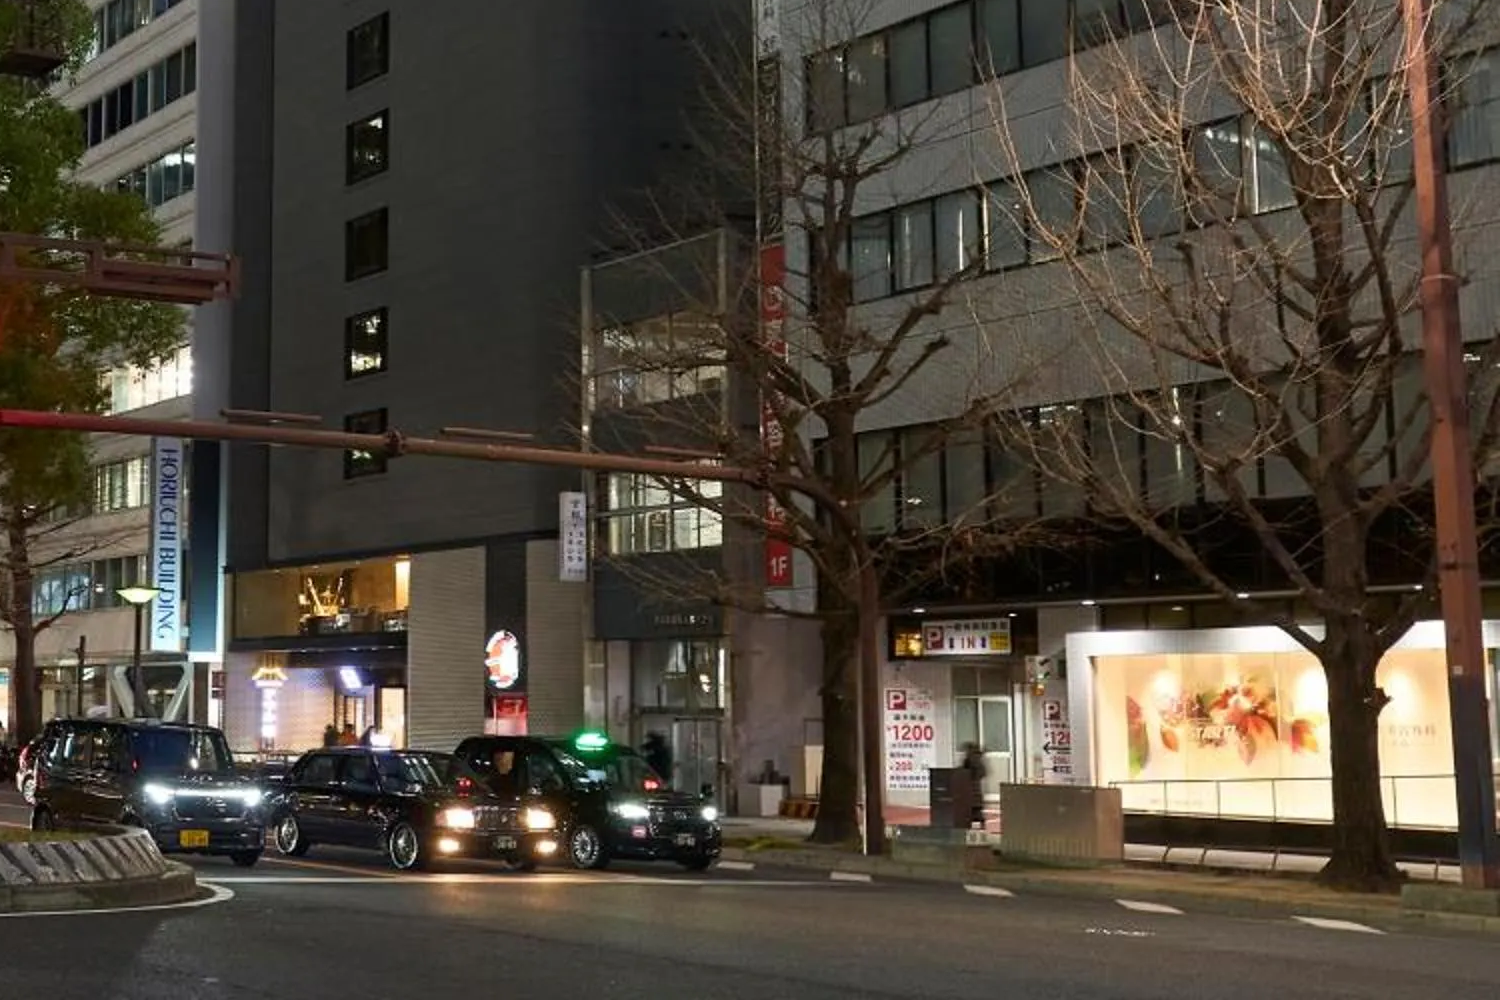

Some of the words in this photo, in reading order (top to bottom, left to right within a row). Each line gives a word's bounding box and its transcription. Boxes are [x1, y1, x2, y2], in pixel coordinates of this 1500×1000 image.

[159, 448, 179, 541] HORIUCHI
[770, 557, 788, 577] 1F
[157, 546, 177, 640] BUILDING
[927, 628, 942, 649] P
[889, 691, 905, 709] P
[1045, 703, 1060, 720] P
